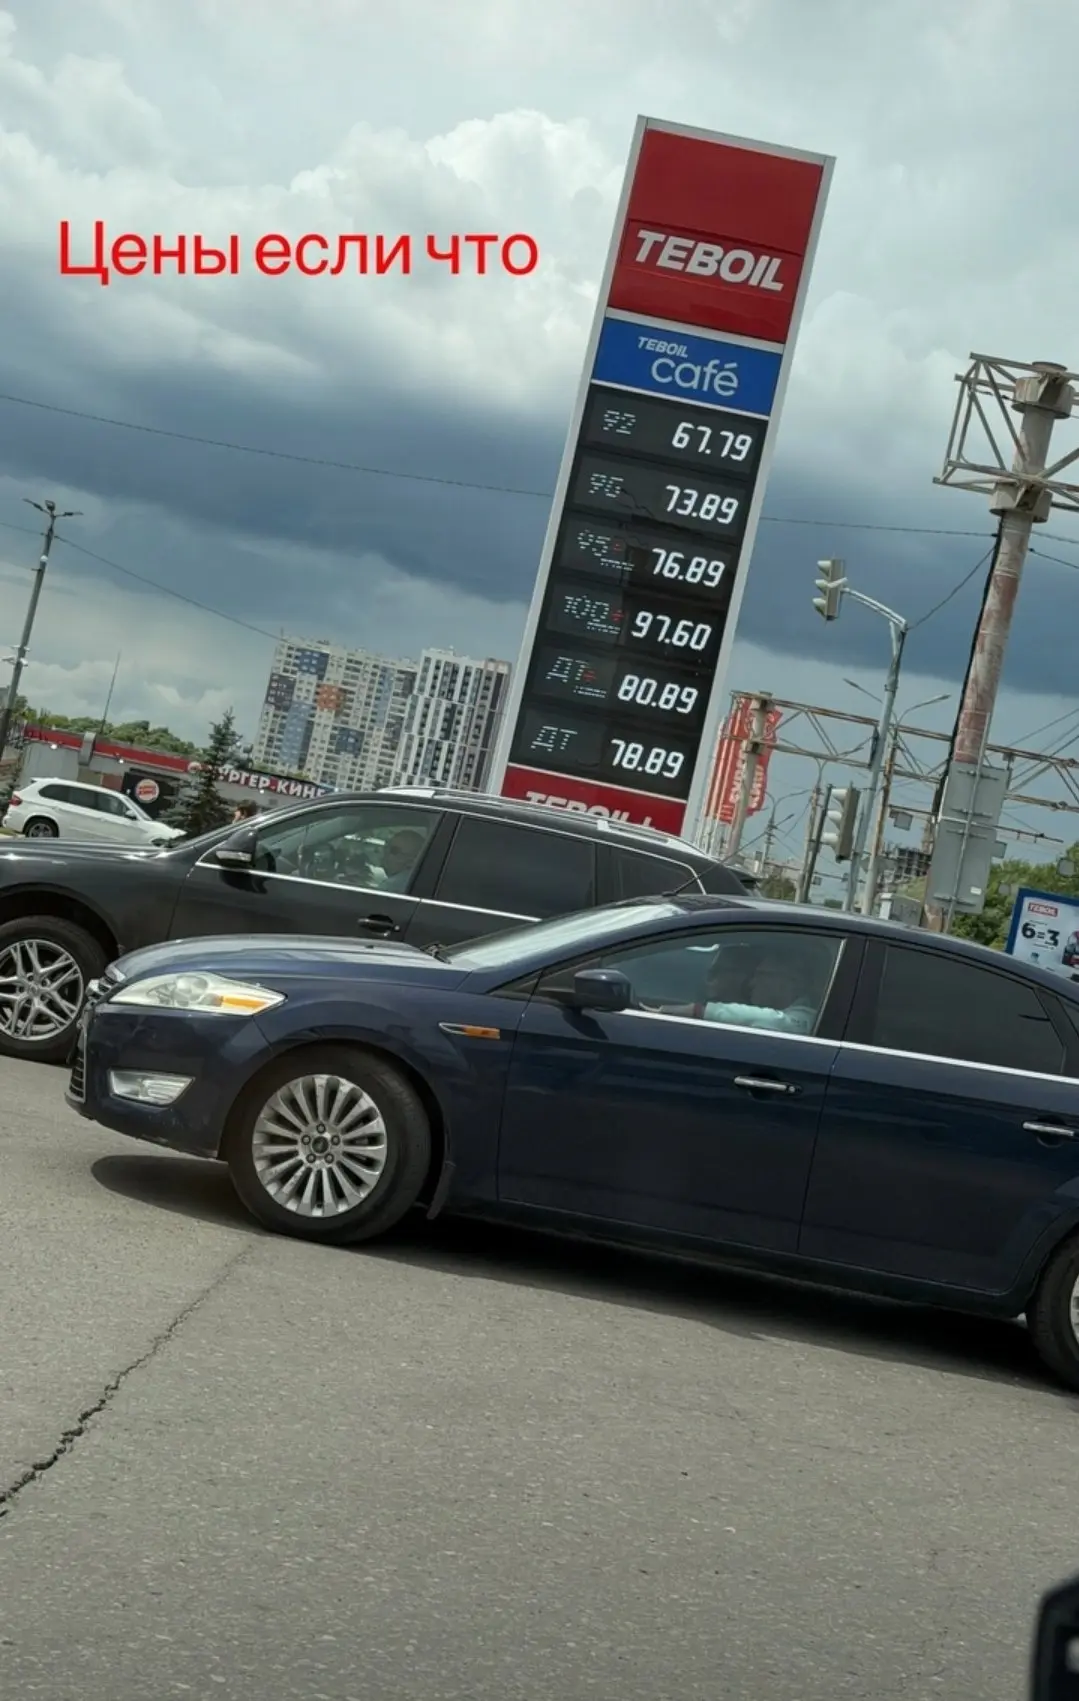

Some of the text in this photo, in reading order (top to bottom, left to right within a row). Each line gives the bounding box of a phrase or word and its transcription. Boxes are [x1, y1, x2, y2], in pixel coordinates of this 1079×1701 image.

[634, 229, 785, 293] TEBOIL
[637, 336, 688, 358] TEBOIL
[651, 357, 739, 397] café
[672, 421, 753, 462] 67.79
[665, 484, 739, 525] 73.89
[652, 547, 726, 588] 76.89
[631, 610, 712, 652] 97.60
[617, 673, 699, 714] 80.89
[610, 739, 685, 779] 78.89
[1021, 922, 1060, 946] 6=3
